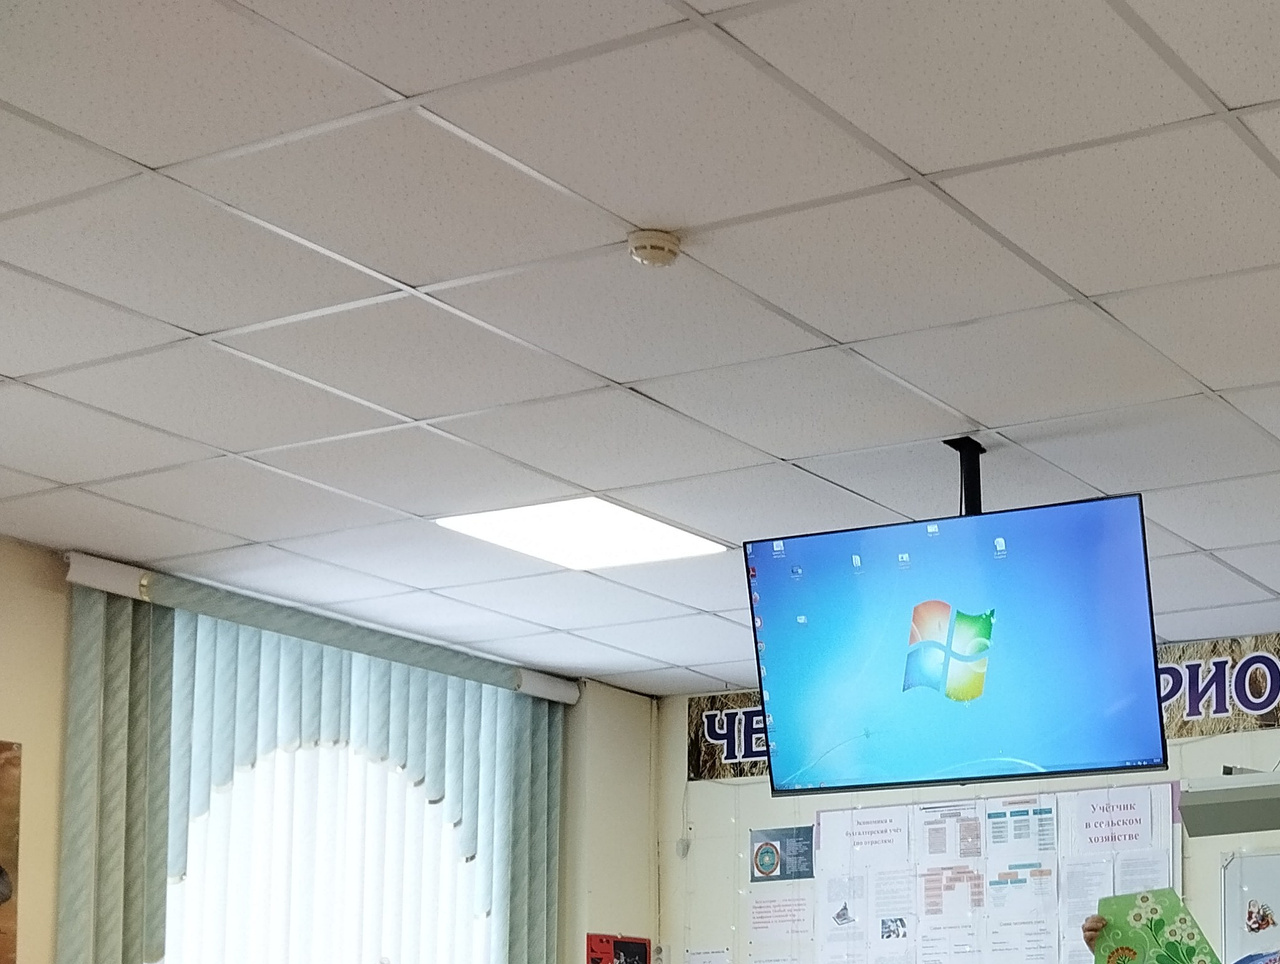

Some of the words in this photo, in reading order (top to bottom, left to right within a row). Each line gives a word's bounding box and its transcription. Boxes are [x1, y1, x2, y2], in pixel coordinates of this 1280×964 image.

[1091, 803, 1136, 814] Учётчик
[1085, 821, 1091, 829] в
[1094, 817, 1142, 829] сельском
[1088, 832, 1140, 844] хозяйстве
